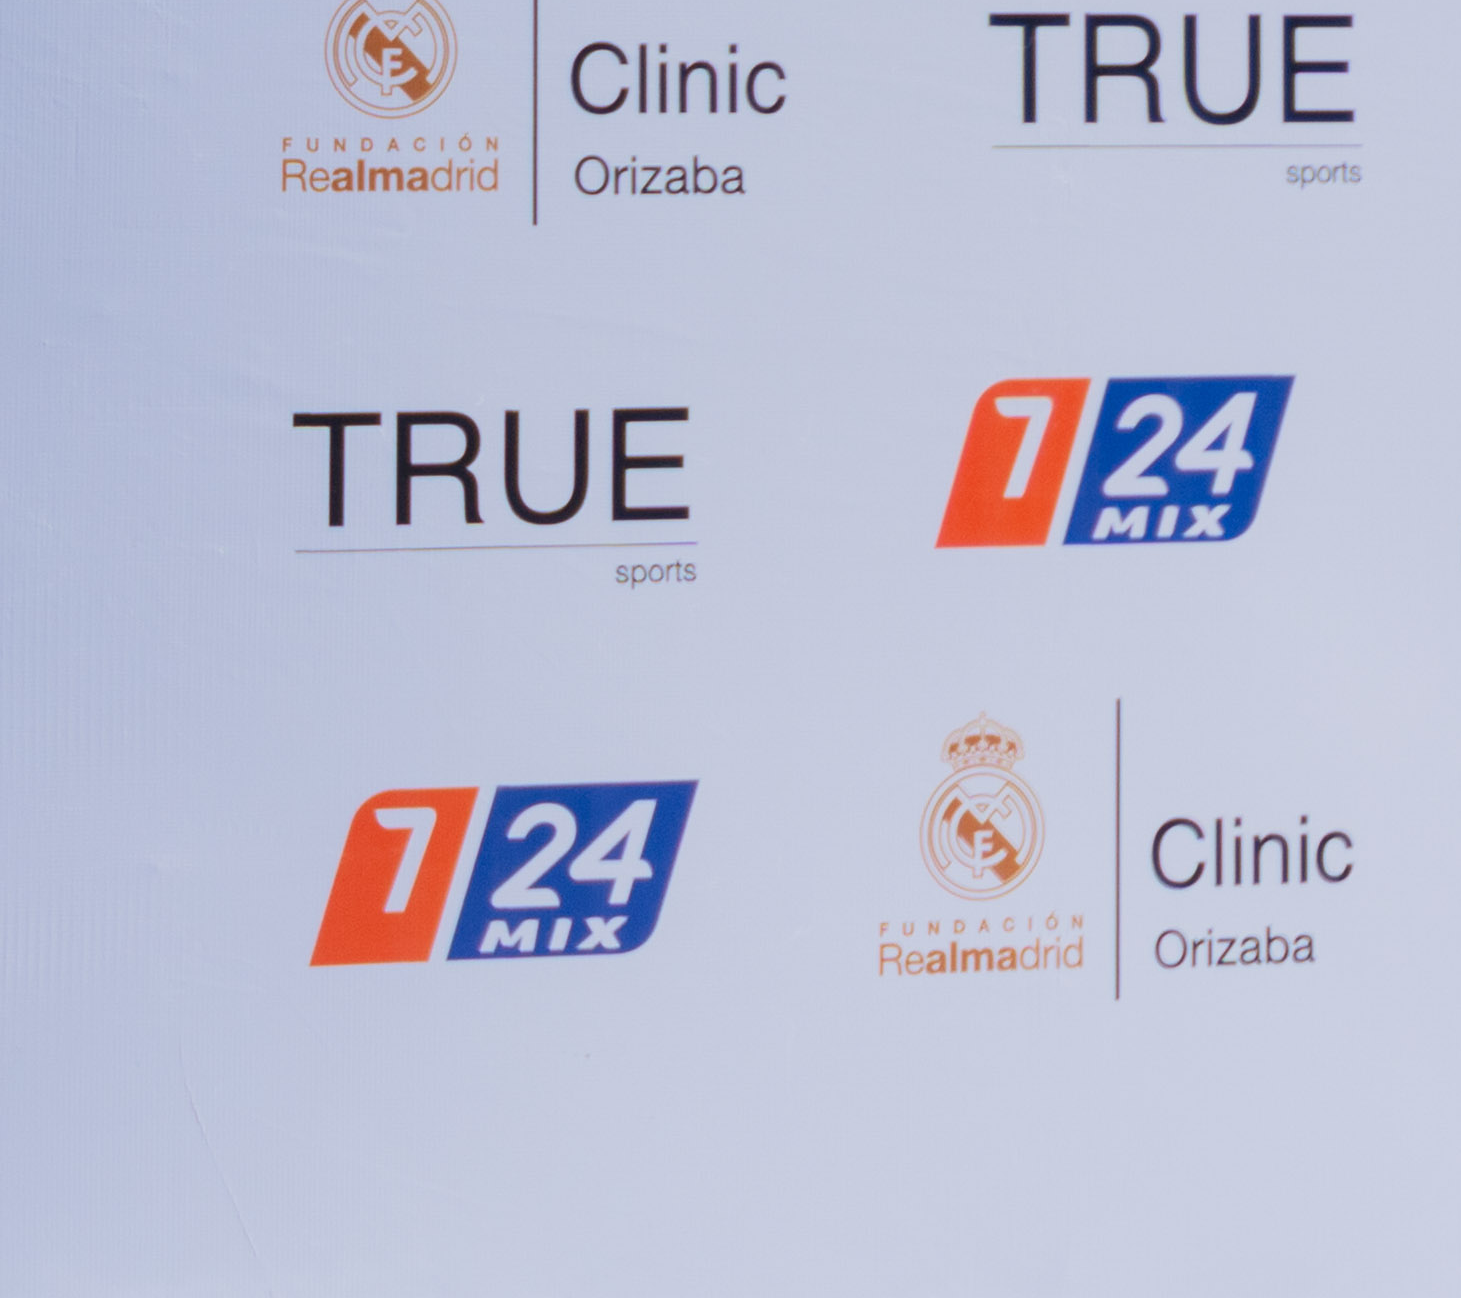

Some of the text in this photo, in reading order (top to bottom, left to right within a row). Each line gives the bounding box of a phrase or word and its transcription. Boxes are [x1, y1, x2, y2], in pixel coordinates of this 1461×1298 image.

[571, 42, 785, 114] Clinic
[989, 14, 1354, 125] TRUE
[282, 133, 498, 152] FUNDACIÓN
[282, 159, 498, 192] Realmadrid
[575, 156, 745, 195] Orizaba
[1286, 162, 1362, 189] sports
[1100, 392, 1257, 499] 24
[293, 408, 689, 526] TRUE
[1092, 503, 1232, 543] MIX
[616, 561, 696, 589] sports
[488, 799, 657, 911] 24
[1152, 816, 1352, 889] Clinic
[478, 915, 628, 958] MIX
[880, 913, 1083, 936] FUNDACIÓN
[880, 937, 1082, 975] Realmadrid
[1155, 927, 1314, 968] Orizaba
